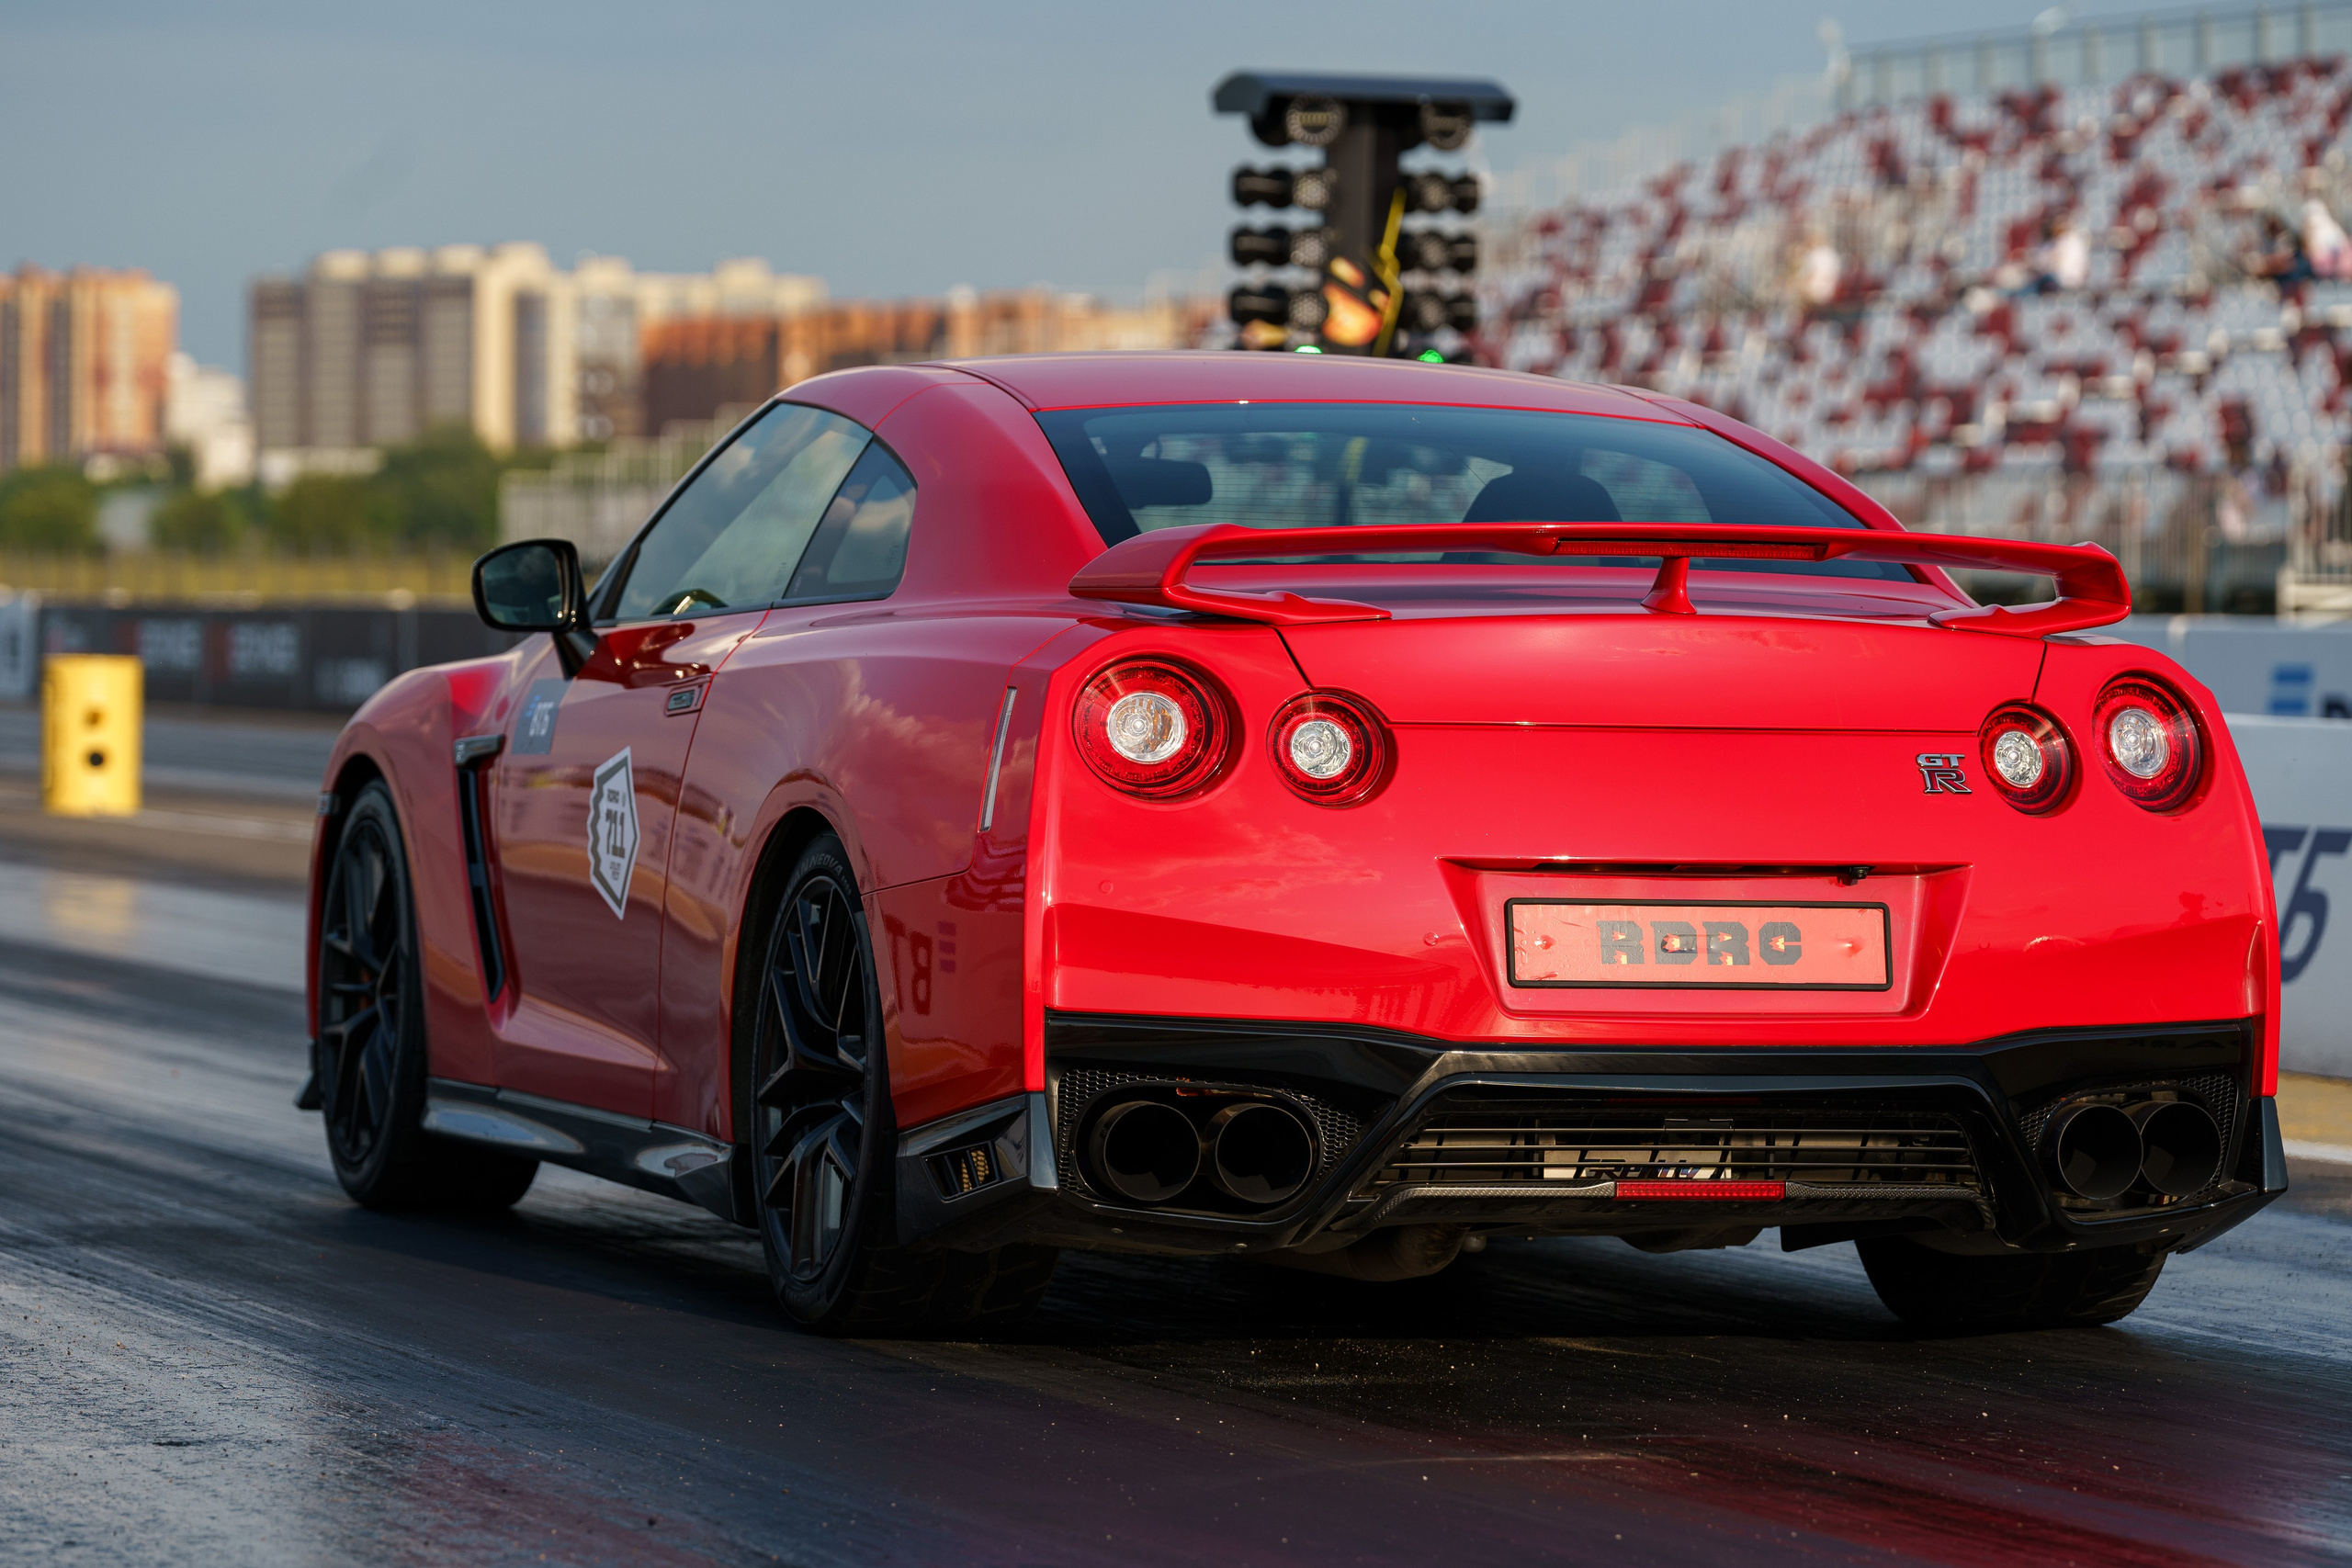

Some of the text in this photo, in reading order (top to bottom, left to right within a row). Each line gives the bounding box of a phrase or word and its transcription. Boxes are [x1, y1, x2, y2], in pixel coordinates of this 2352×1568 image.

[1917, 753, 1964, 768] GT
[1919, 768, 1973, 794] R
[809, 852, 843, 876] NEOVA
[1596, 920, 1803, 965] RDRC
